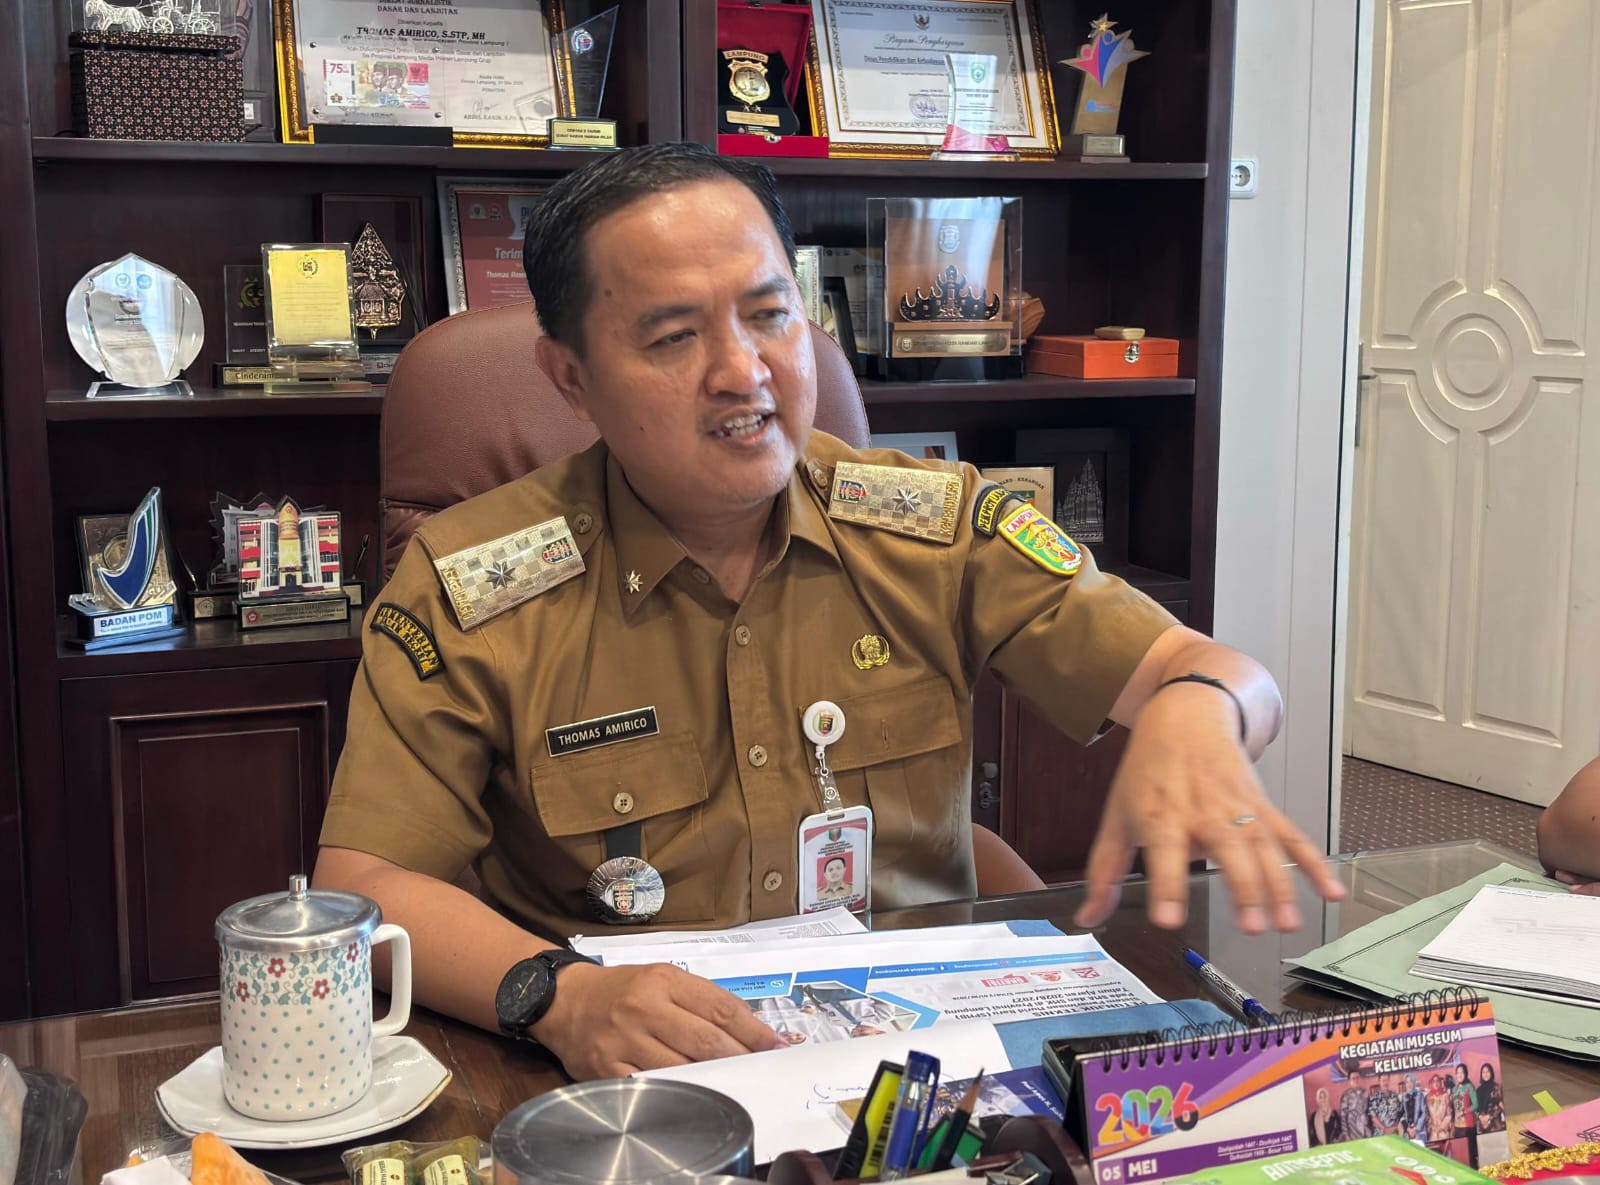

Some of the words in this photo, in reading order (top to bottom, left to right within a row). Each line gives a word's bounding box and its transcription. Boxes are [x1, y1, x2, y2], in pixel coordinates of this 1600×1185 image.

[377, 5, 403, 13] DASAR
[421, 7, 458, 15] LANJUTAN
[398, 28, 440, 39] AMIRICO,
[441, 30, 470, 40] S.STP,
[471, 32, 486, 40] MH
[727, 51, 765, 61] LAMPUNG
[330, 63, 343, 73] 75
[495, 247, 523, 260] Terim
[100, 615, 136, 628] BADAN
[138, 610, 162, 621] POM
[558, 727, 601, 746] THOMAS
[605, 718, 647, 736] AMIRICO
[1012, 993, 1064, 1003] 2026/2027
[944, 1006, 991, 1015] Lampung
[992, 1002, 1033, 1010] Provinsi
[1340, 1038, 1403, 1059] KEGIATAN
[1406, 1030, 1461, 1049] MUSEUM
[1375, 1053, 1432, 1073] KELILING
[1095, 1082, 1199, 1146] 2026
[1102, 1166, 1121, 1180] 05
[1128, 1158, 1157, 1178] MEI
[1261, 1150, 1363, 1182] ANTISEPTIC
